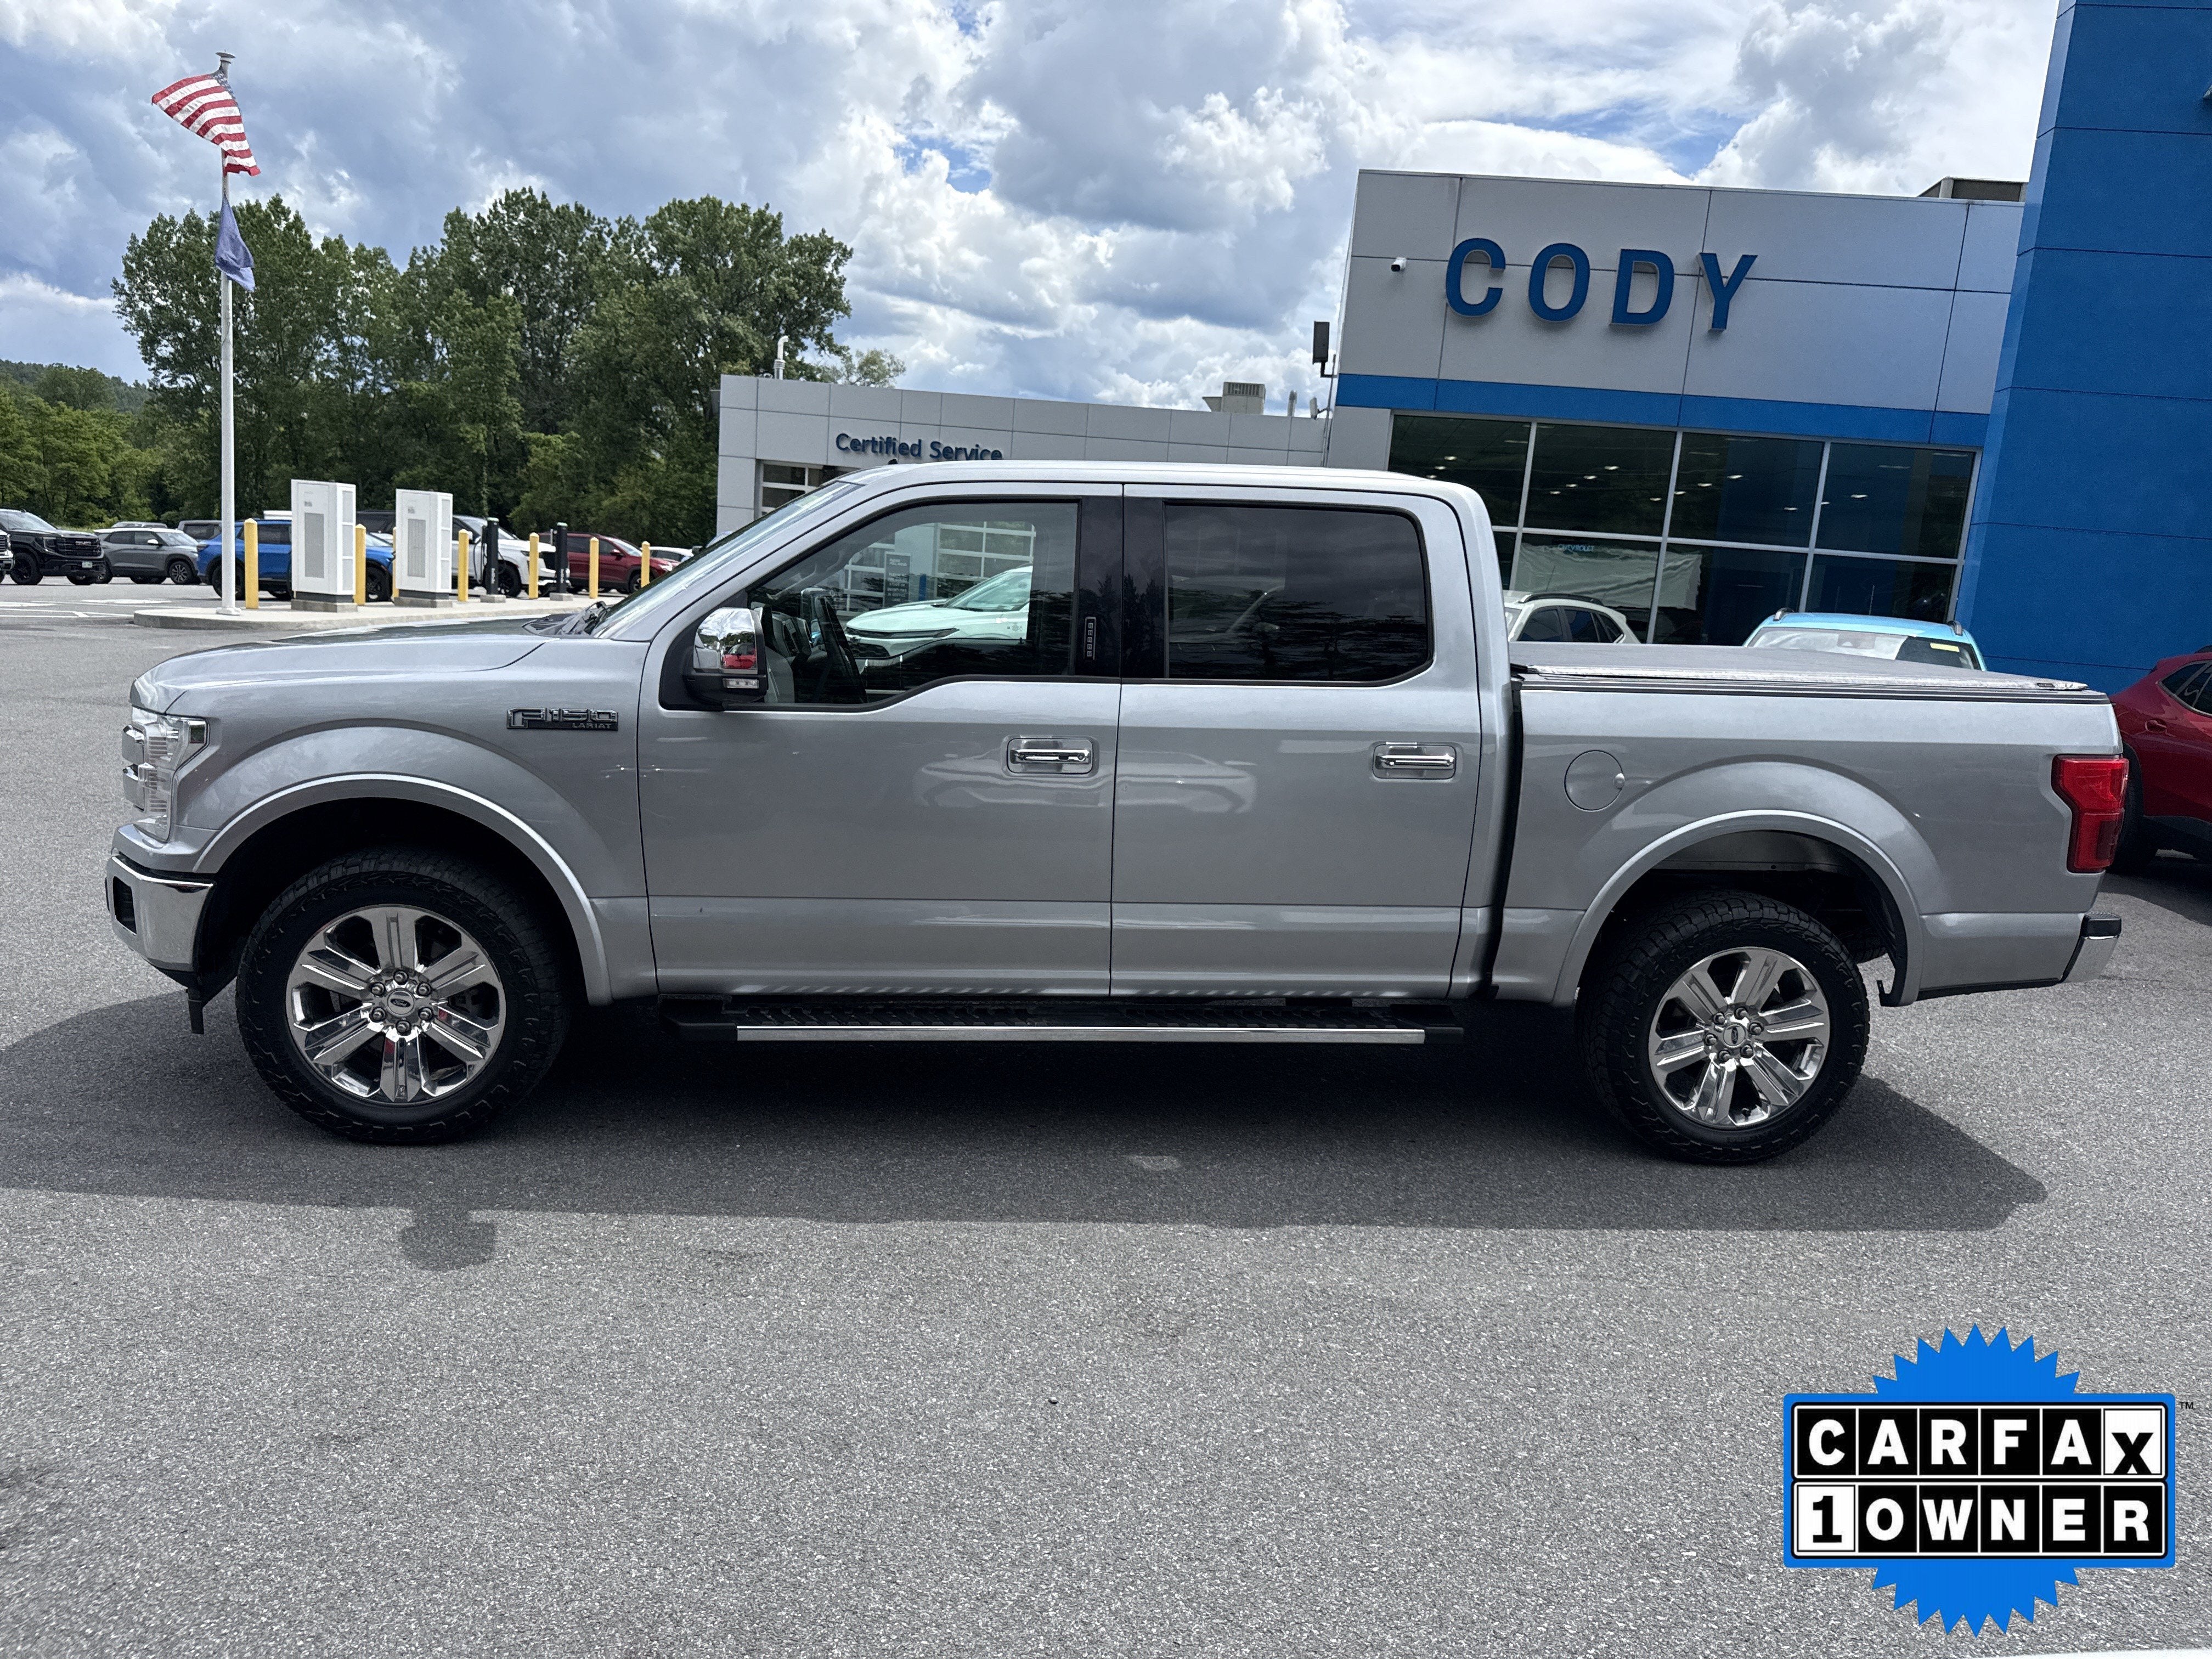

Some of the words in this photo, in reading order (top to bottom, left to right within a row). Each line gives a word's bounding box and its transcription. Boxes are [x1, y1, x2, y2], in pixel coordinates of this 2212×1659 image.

[1446, 238, 1758, 331] CODY
[836, 433, 922, 458] Certified
[929, 441, 1002, 460] Service
